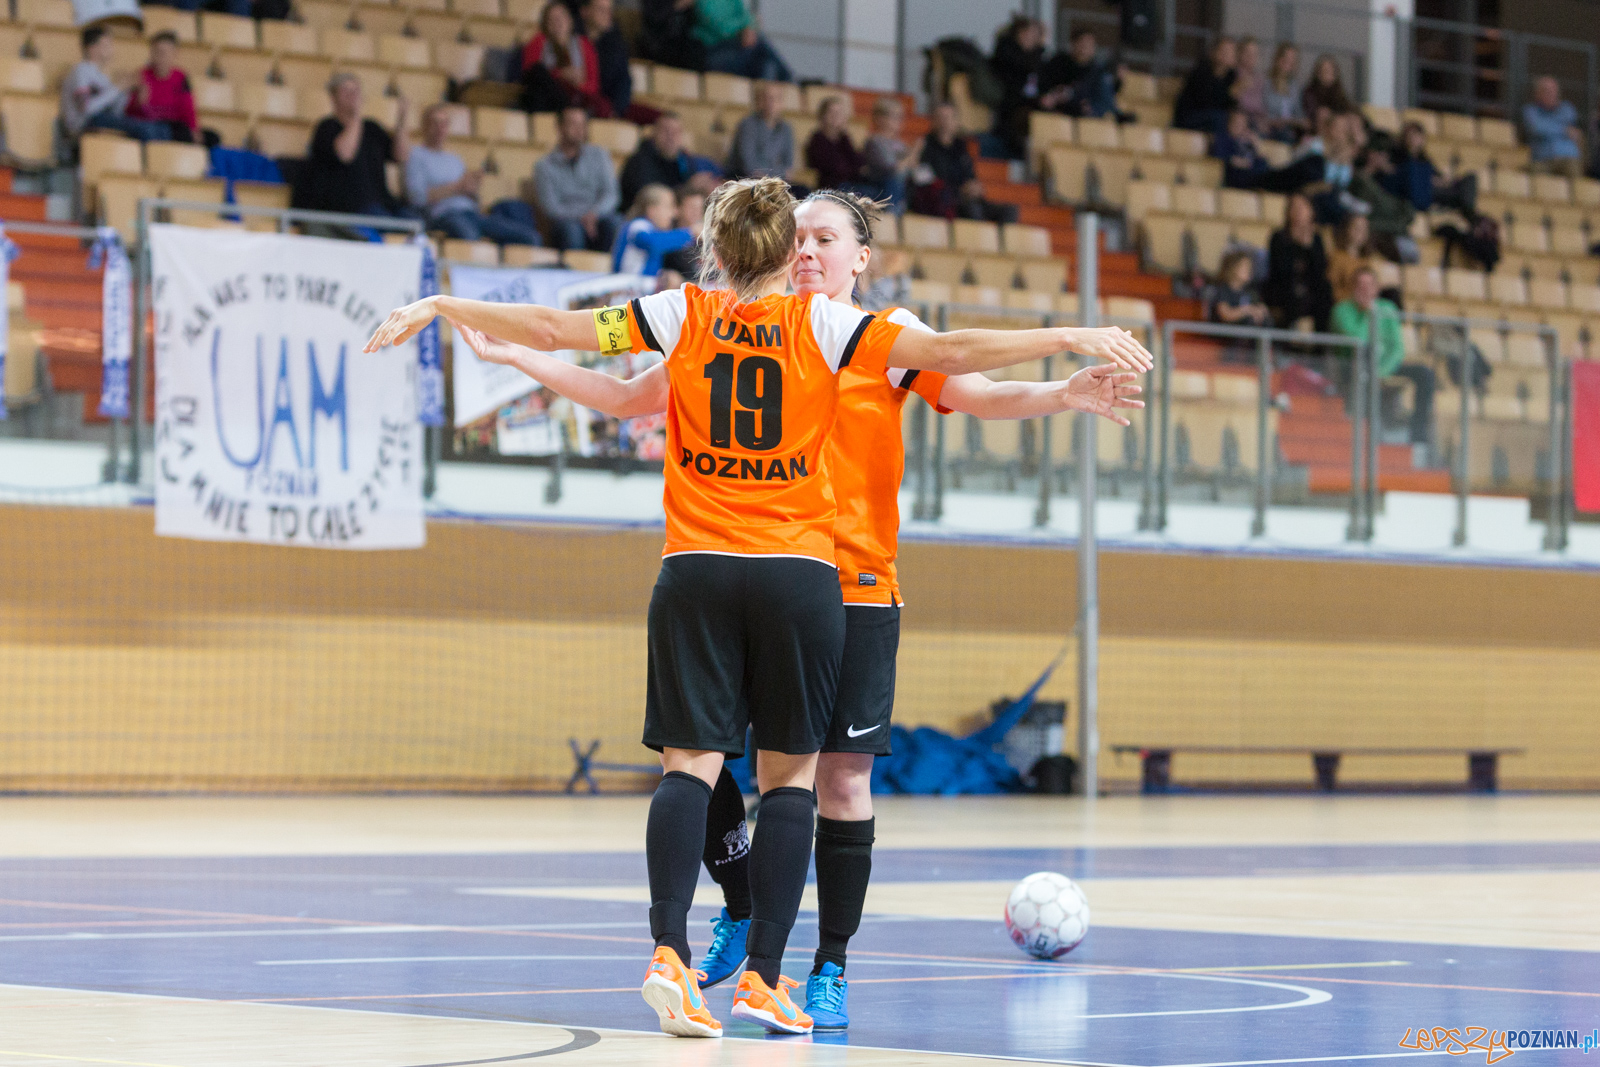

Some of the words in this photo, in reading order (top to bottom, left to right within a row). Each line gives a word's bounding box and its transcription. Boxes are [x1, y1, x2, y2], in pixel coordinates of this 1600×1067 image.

[262, 273, 288, 302] TO
[597, 308, 627, 325] C
[712, 316, 783, 347] UAM
[208, 326, 349, 472] UAM
[703, 352, 783, 451] 19
[680, 446, 809, 481] POZNAŃ
[268, 503, 300, 540] TO
